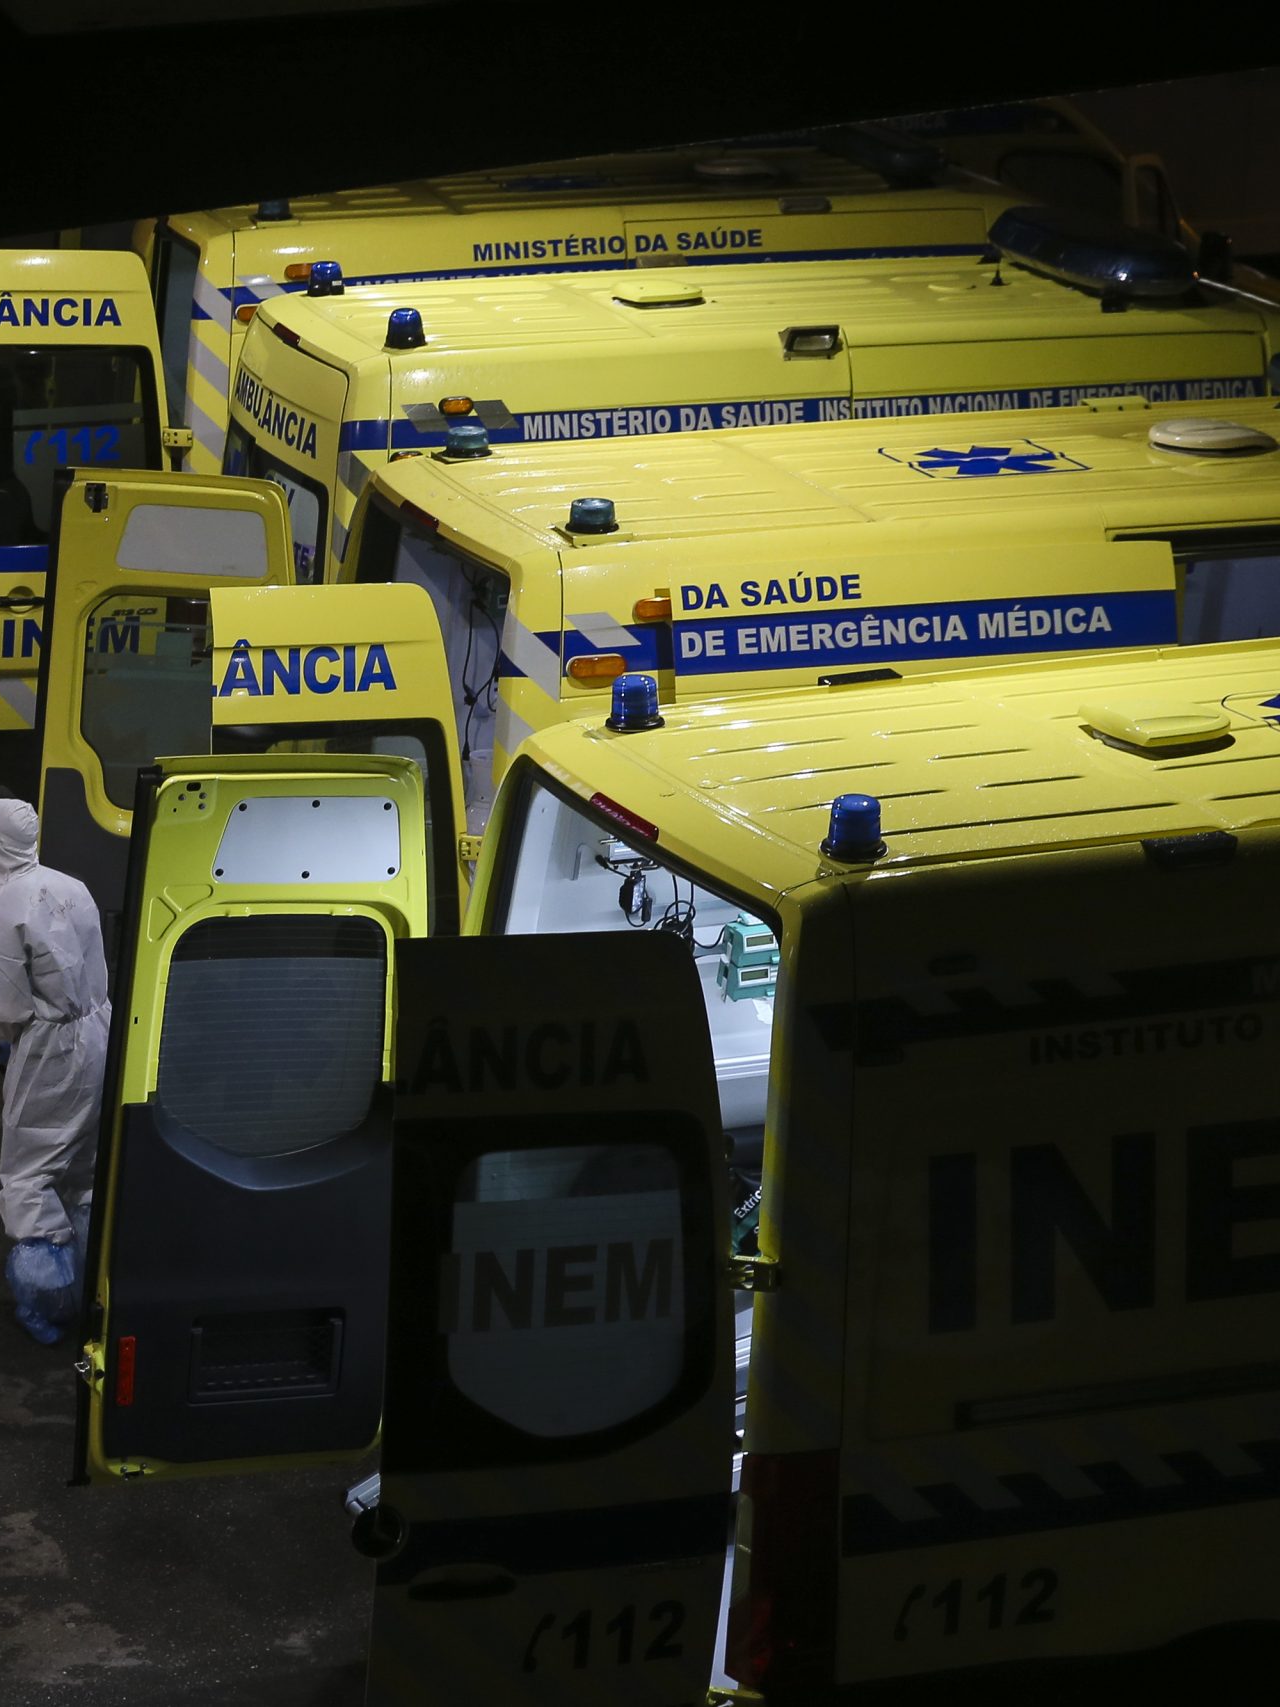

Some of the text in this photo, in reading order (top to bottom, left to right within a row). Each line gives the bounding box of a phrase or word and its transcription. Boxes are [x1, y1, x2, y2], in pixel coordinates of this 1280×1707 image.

[473, 226, 763, 262] MINISTÉRIO DA SAÚDE
[523, 406, 671, 440] MINISTÉRIO
[680, 406, 714, 432] DA
[721, 399, 805, 428] SAÚDE
[818, 397, 923, 421] INSTITUTO
[928, 392, 1019, 414] NACIONAL
[1030, 389, 1053, 408] DE
[48, 424, 120, 464] 112
[680, 571, 862, 610] DA SAÚDE
[680, 604, 1112, 659] DE EMERGÊNCIA MÉDICA
[211, 639, 397, 697] ÂNCIA
[1030, 1013, 1263, 1066] INSTITUTO
[734, 1185, 762, 1219] Extric
[438, 1238, 674, 1333] INEM
[932, 1567, 1058, 1635] 112
[562, 1599, 686, 1670] 112
